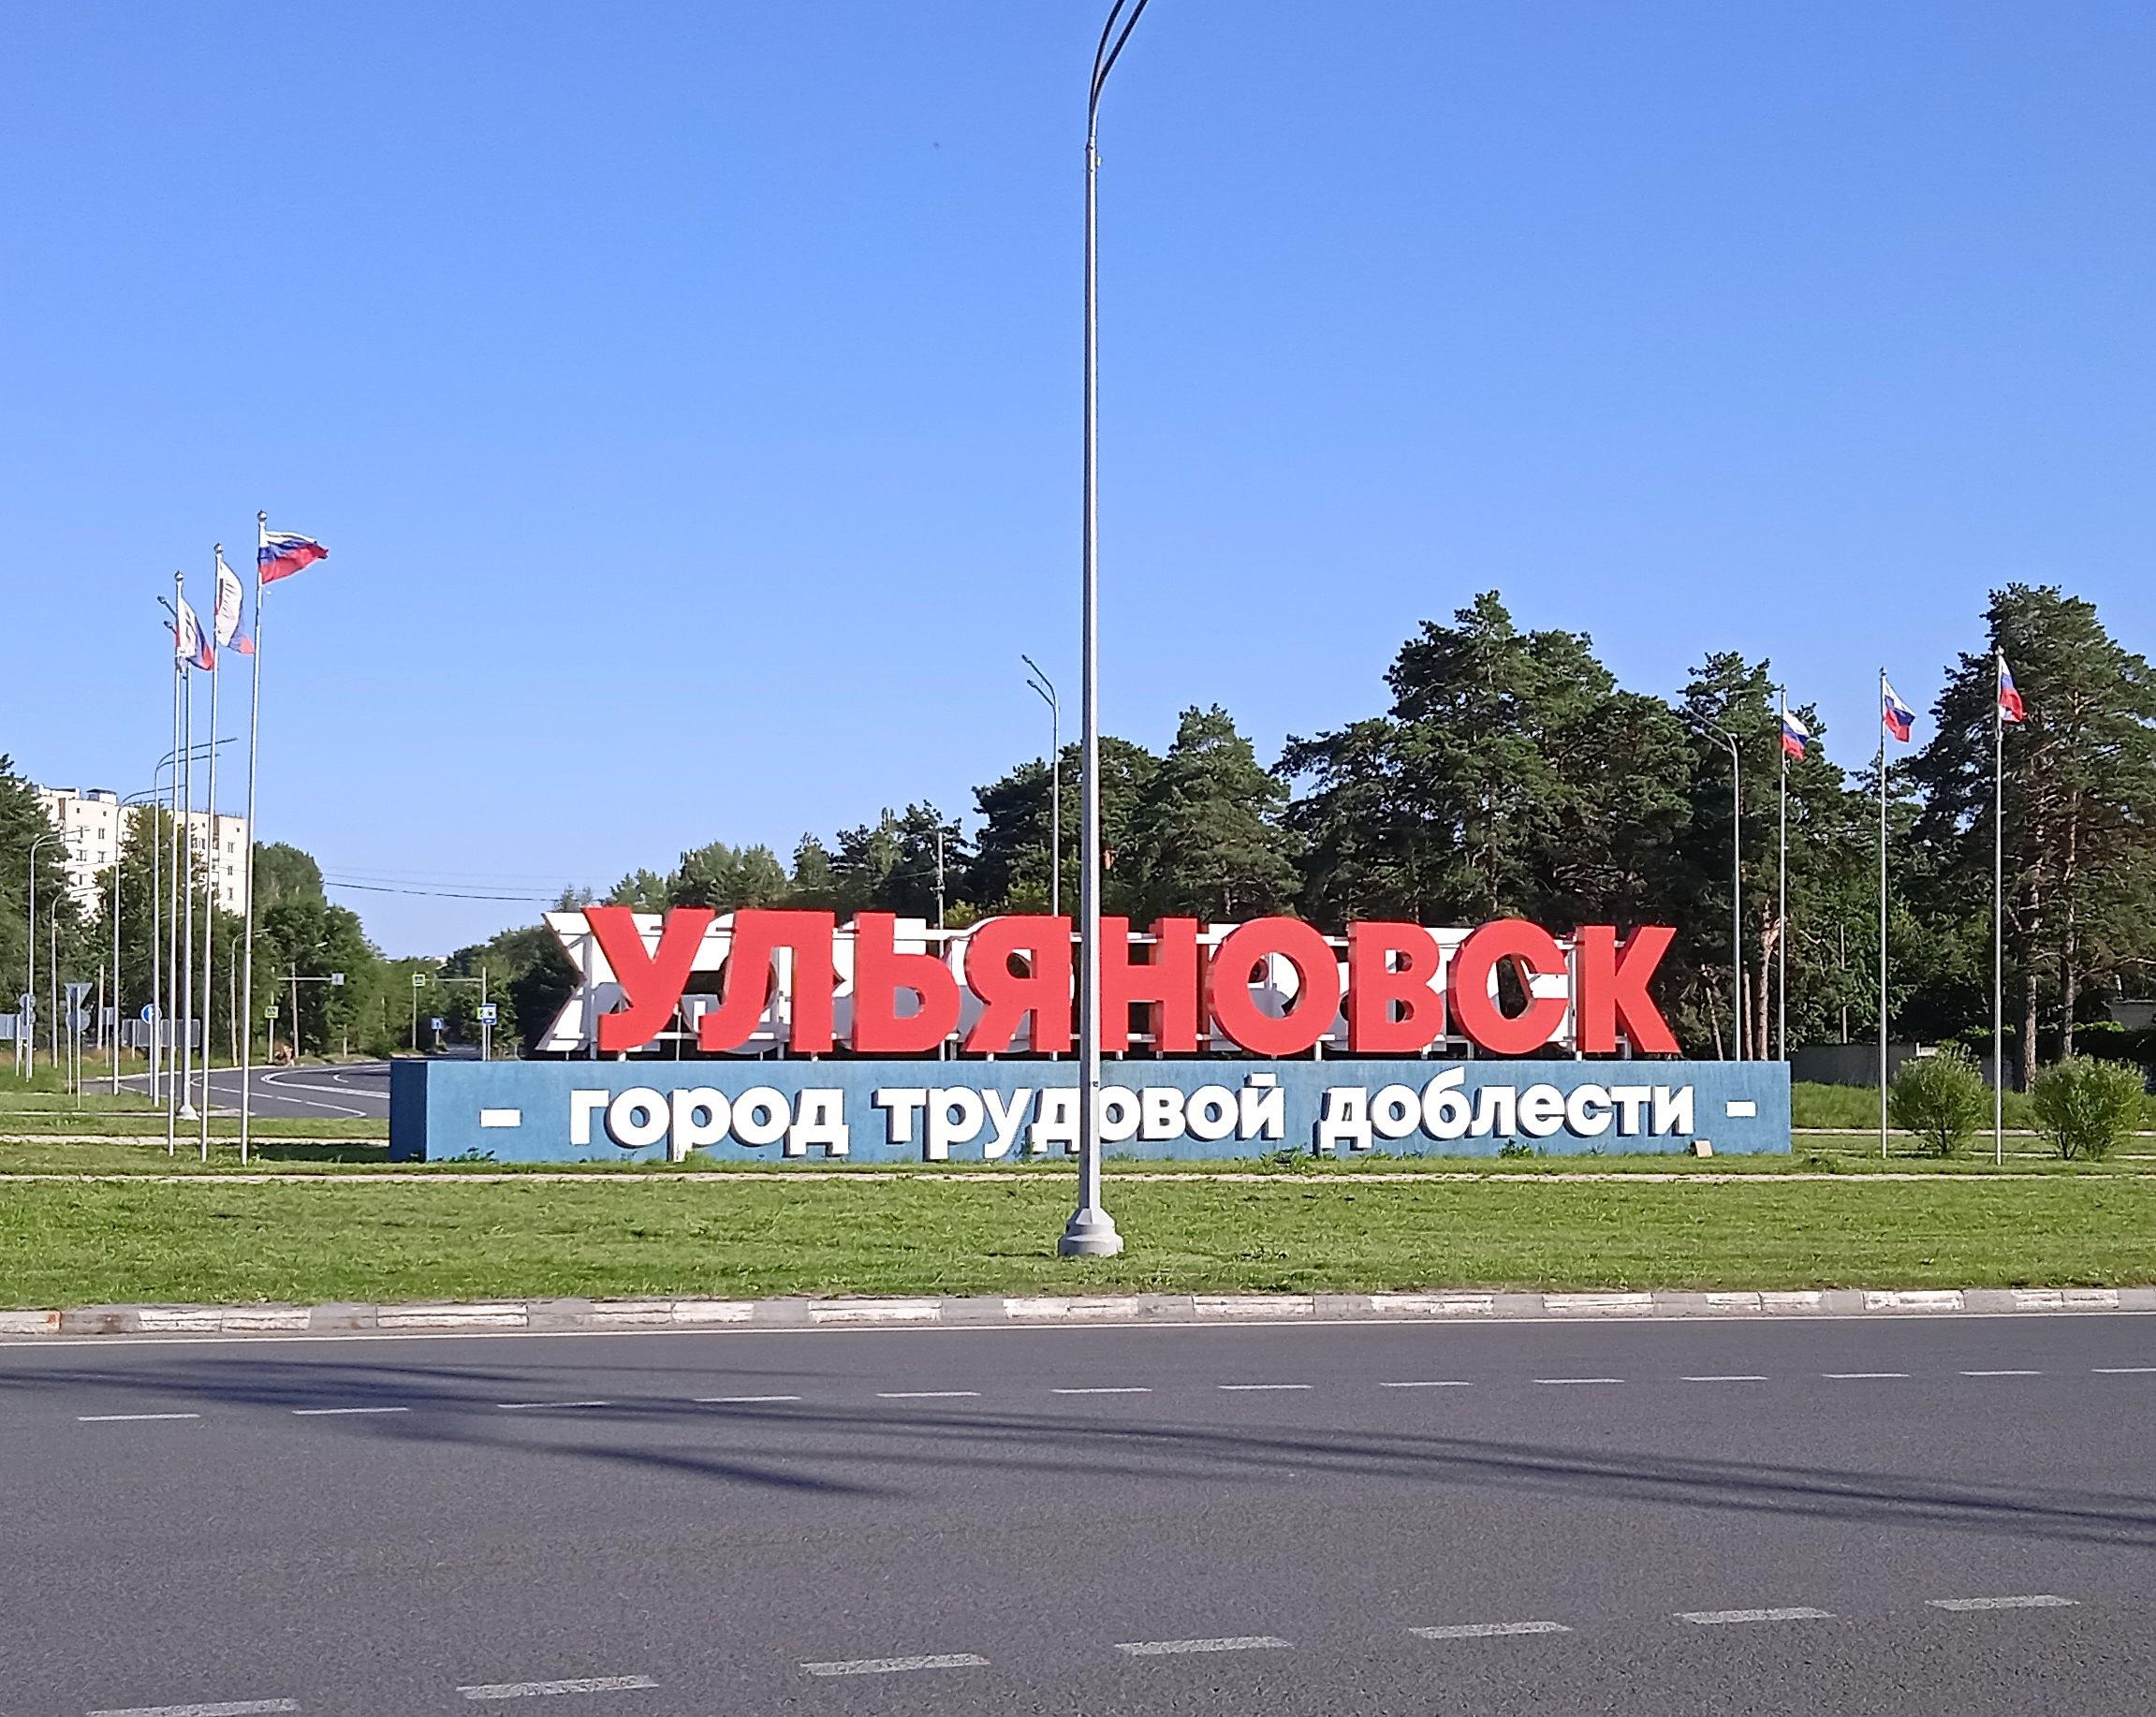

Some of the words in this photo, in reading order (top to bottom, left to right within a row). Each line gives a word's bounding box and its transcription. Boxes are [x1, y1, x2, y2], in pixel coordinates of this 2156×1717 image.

[583, 907, 1679, 1055] УЛЬЯНОВСК
[569, 1086, 849, 1162] город
[875, 1073, 1285, 1161] трудовой
[1319, 1065, 1694, 1152] доблести
